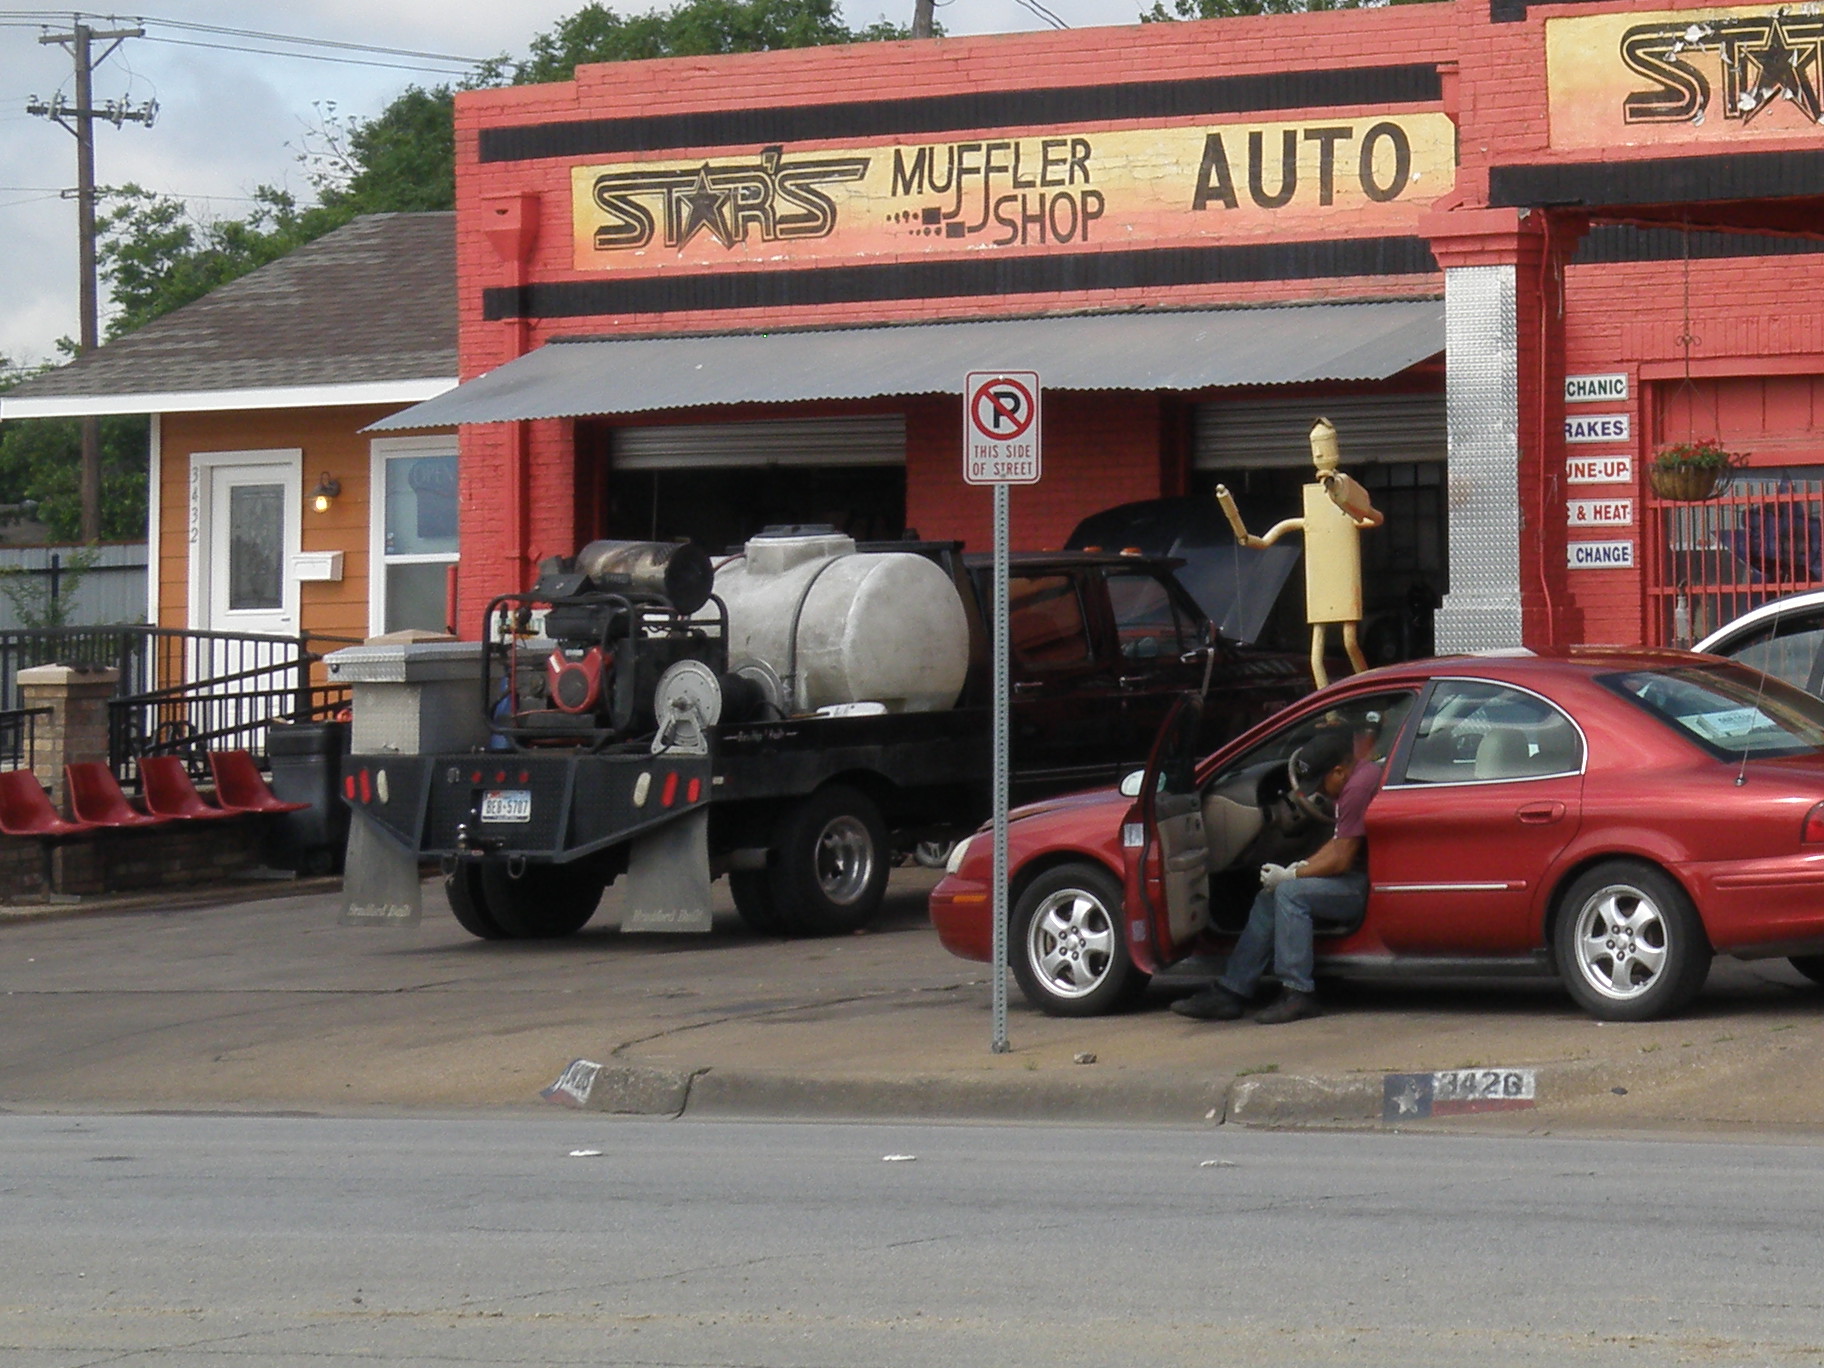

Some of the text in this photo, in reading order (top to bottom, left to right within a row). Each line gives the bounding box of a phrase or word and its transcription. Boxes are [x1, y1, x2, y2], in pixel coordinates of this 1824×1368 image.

[1192, 121, 1412, 212] AUTO
[892, 137, 1091, 233] MUFFLER
[994, 189, 1106, 246] SHOP
[1566, 378, 1625, 398] CHANIC
[1565, 419, 1624, 438] RAKES
[974, 444, 1031, 459] THIS SIDE
[972, 461, 1032, 476] OF STREET
[1576, 505, 1586, 521] &
[1593, 504, 1628, 521] HEAT
[1576, 546, 1630, 564] CHANGE
